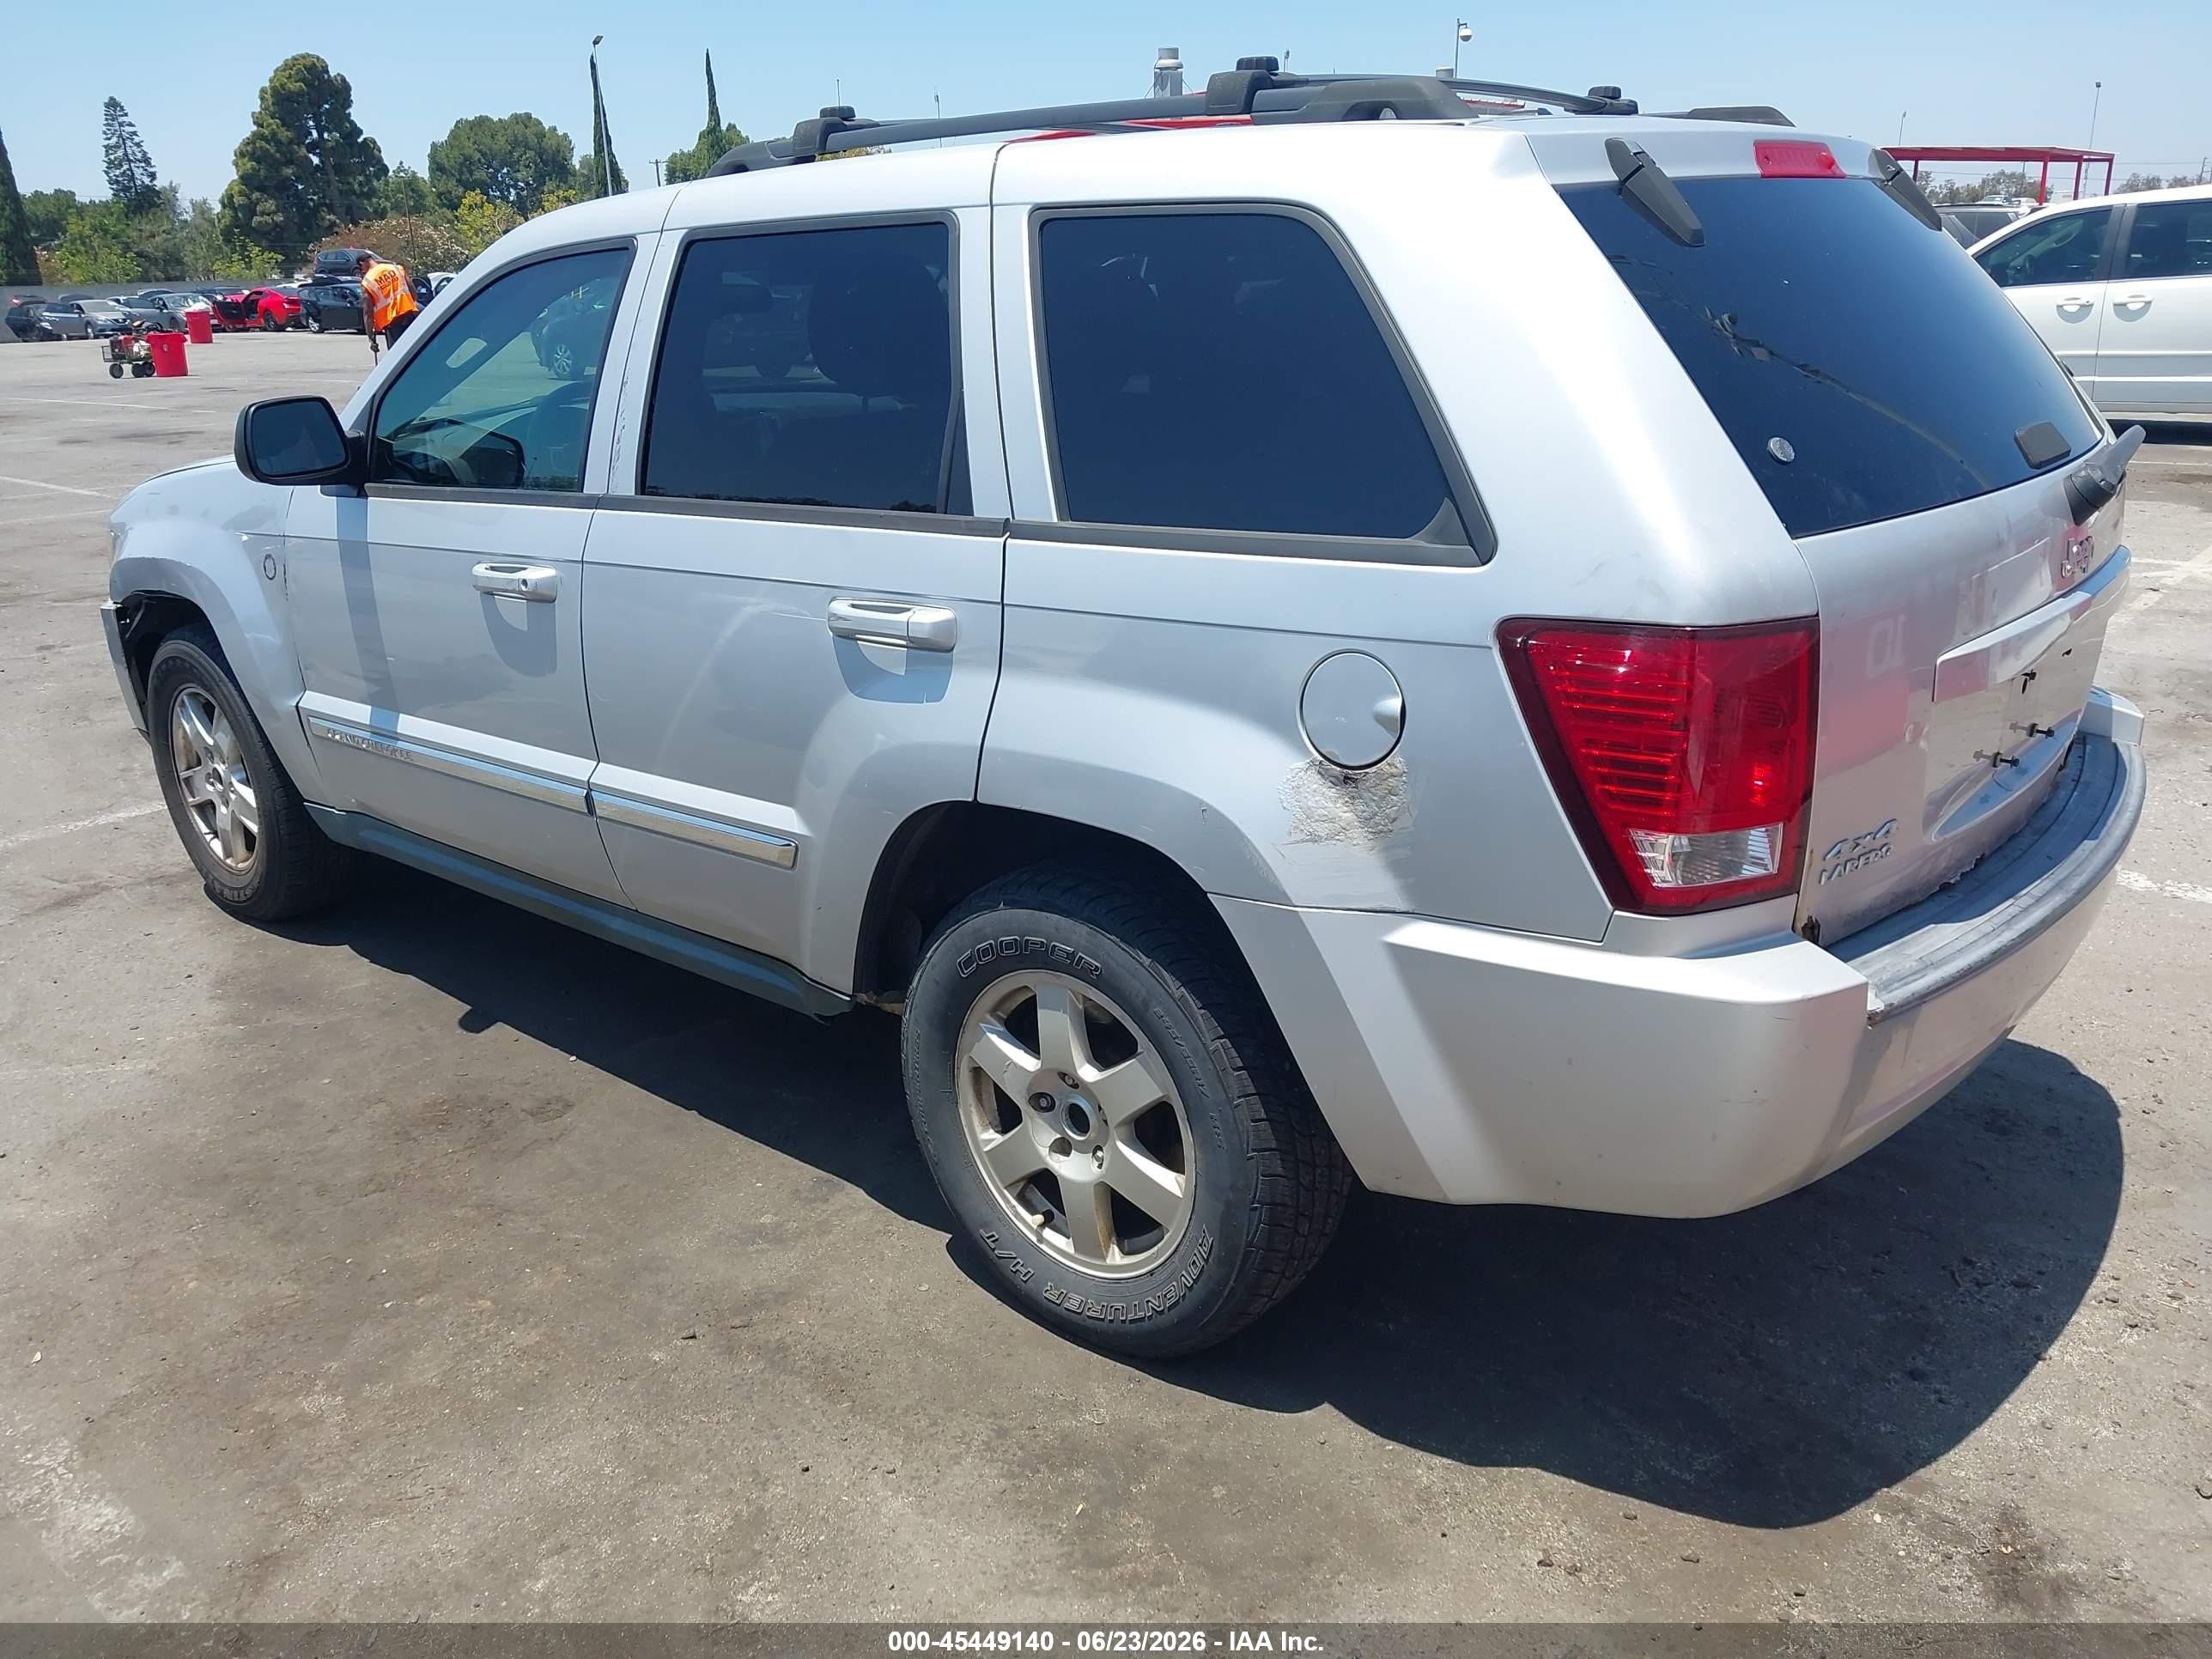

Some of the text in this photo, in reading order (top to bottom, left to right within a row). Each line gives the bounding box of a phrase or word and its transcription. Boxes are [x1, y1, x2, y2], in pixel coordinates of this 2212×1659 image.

[1823, 817, 1899, 861] 4x4
[956, 935, 1103, 981] COOPER
[979, 1229, 1036, 1283] H/T
[1042, 1222, 1214, 1322] ADVENTURER
